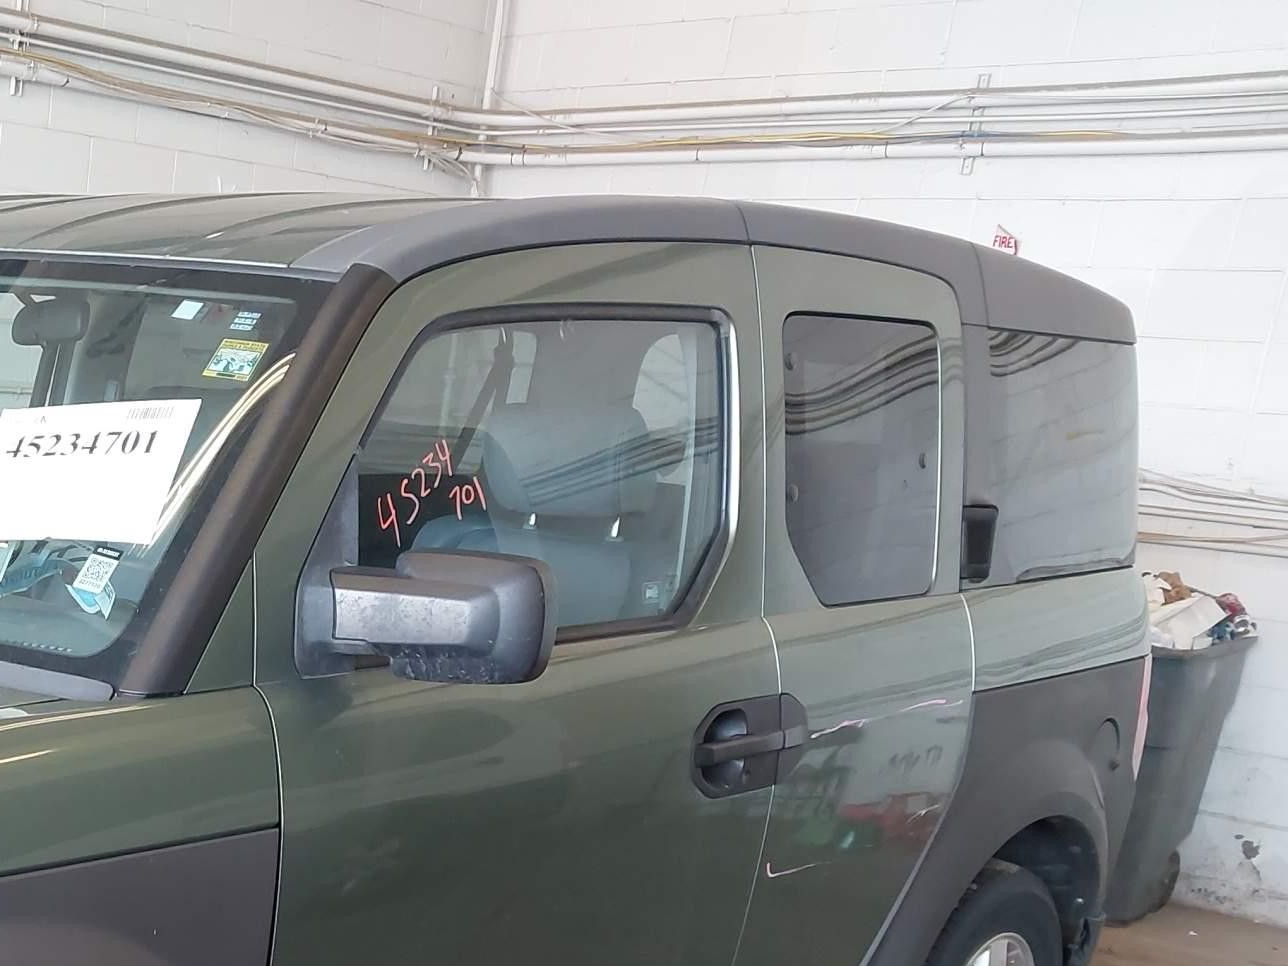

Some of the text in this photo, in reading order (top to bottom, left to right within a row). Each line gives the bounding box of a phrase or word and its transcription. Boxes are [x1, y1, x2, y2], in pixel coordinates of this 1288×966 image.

[993, 235, 1014, 248] FIRE
[6, 430, 158, 457] 45234701
[377, 439, 453, 548] 45234
[449, 476, 486, 520] 701
